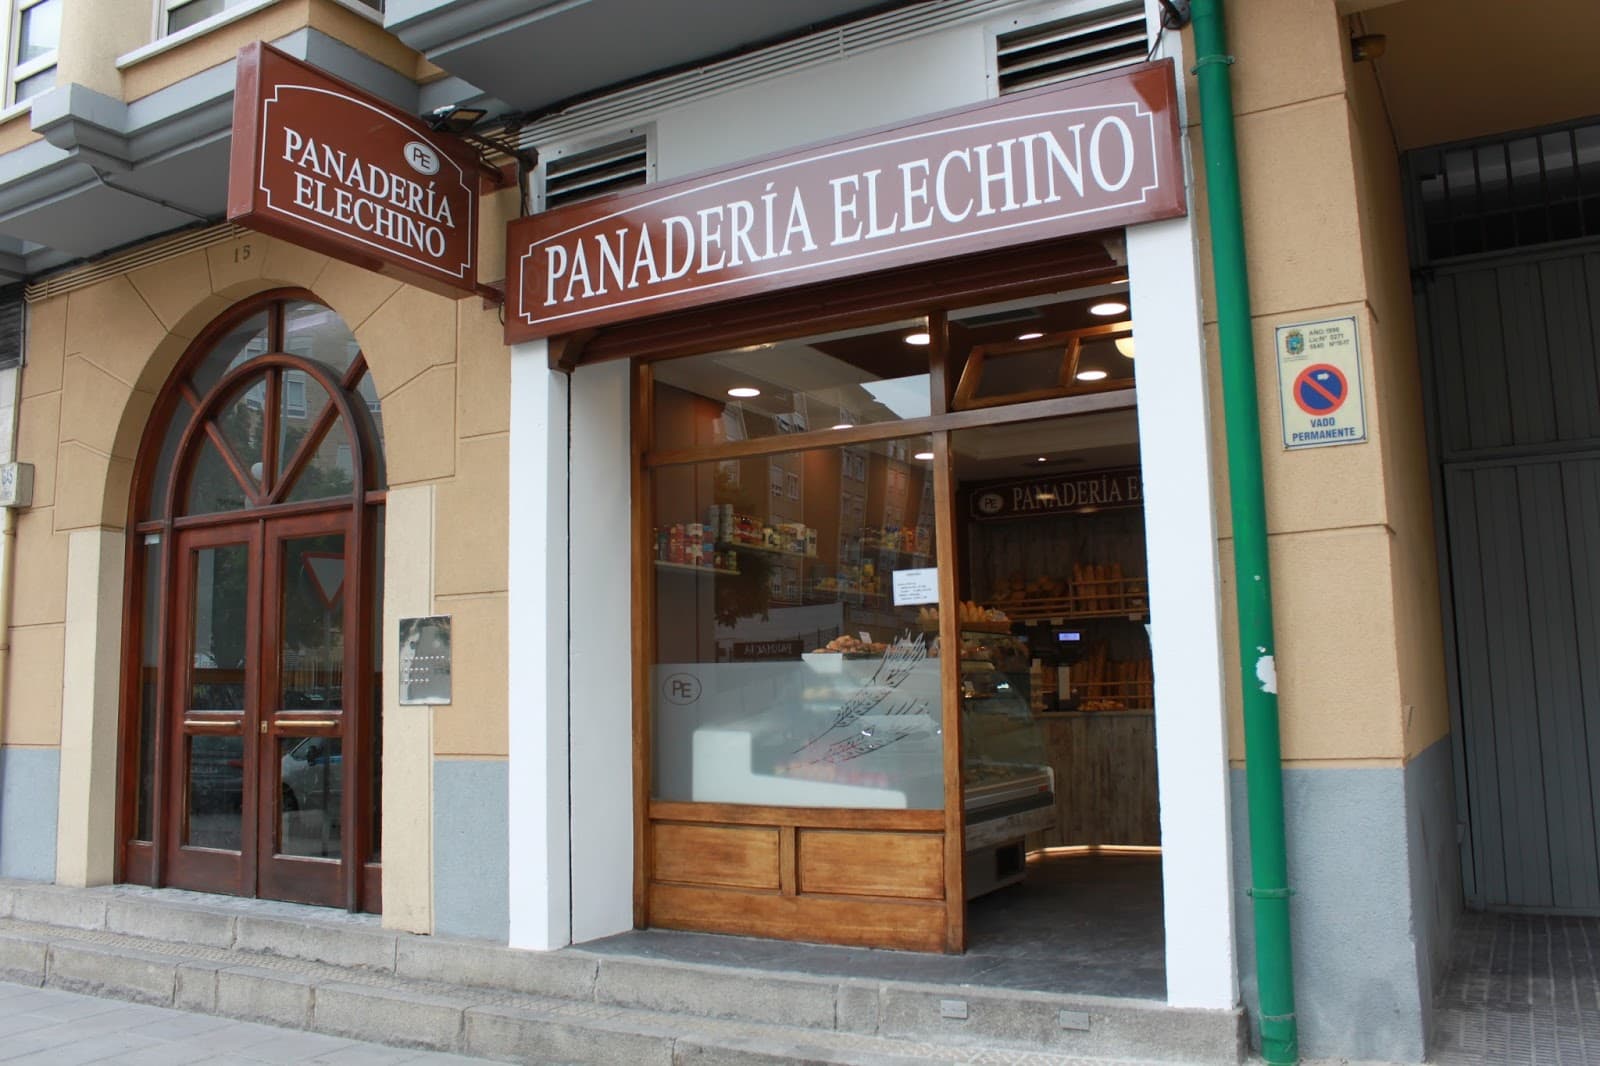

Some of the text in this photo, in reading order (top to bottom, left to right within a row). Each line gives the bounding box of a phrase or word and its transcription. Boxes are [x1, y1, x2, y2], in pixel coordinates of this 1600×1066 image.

[411, 146, 431, 170] PE
[281, 126, 456, 229] PANADERÍA
[293, 171, 446, 257] ELECHINO
[543, 114, 1135, 306] PANADERÍA ELECHINO
[233, 244, 251, 263] 15
[1292, 427, 1356, 441] PERMANENTE
[1310, 416, 1336, 428] VADO
[1013, 474, 1122, 511] PANADERÍA
[1127, 475, 1142, 501] E
[672, 680, 692, 698] PE
